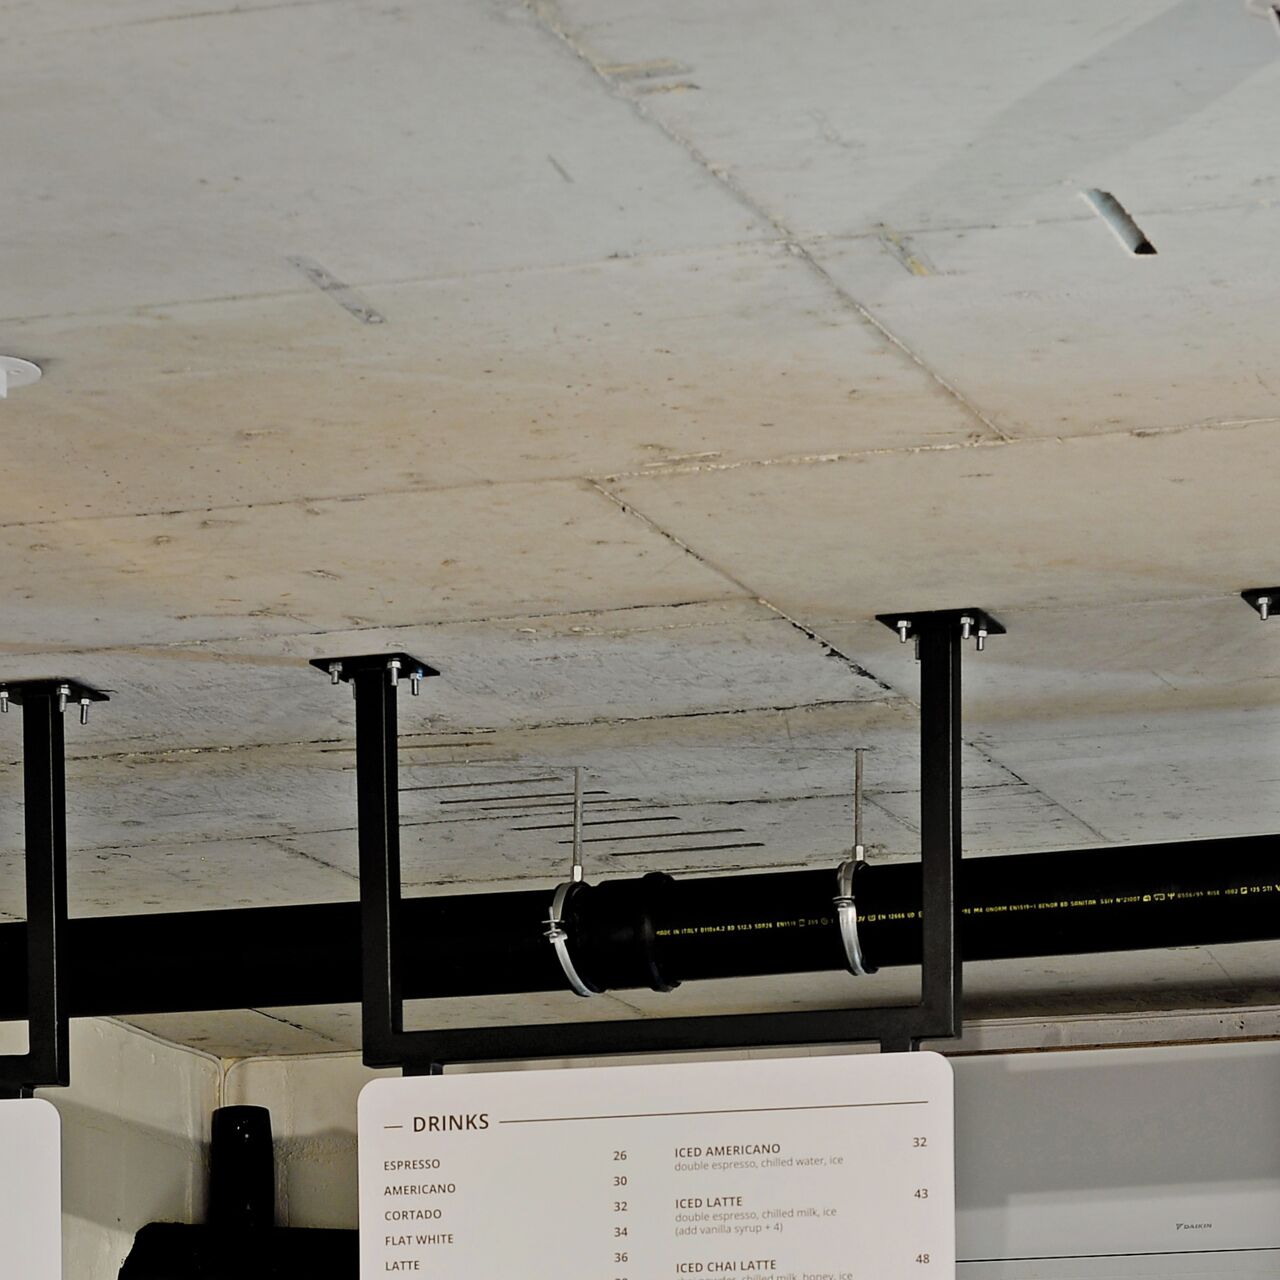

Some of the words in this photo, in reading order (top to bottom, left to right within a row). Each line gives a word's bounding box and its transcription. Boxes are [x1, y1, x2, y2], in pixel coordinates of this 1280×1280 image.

[413, 1113, 489, 1132] DRINKS
[913, 1136, 927, 1148] 32
[613, 1150, 627, 1161] 26
[675, 1147, 702, 1158] ICED
[705, 1143, 781, 1156] AMERICANO
[384, 1158, 440, 1171] ESPRESSO
[614, 1176, 628, 1186] 30
[384, 1183, 456, 1196] AMERICANO
[914, 1188, 928, 1199] 43
[614, 1201, 628, 1212] 32
[676, 1198, 703, 1209] ICED
[706, 1196, 742, 1208] LATTE
[384, 1209, 442, 1221] CORTADO
[614, 1227, 628, 1238] 34
[385, 1235, 412, 1246] FLAT
[416, 1234, 453, 1245] WHITE
[614, 1252, 628, 1263] 36
[915, 1254, 930, 1264] 48
[385, 1260, 420, 1271] LATTE
[676, 1262, 704, 1273] ICED
[707, 1261, 736, 1272] CHAI
[740, 1259, 776, 1271] LATTE
